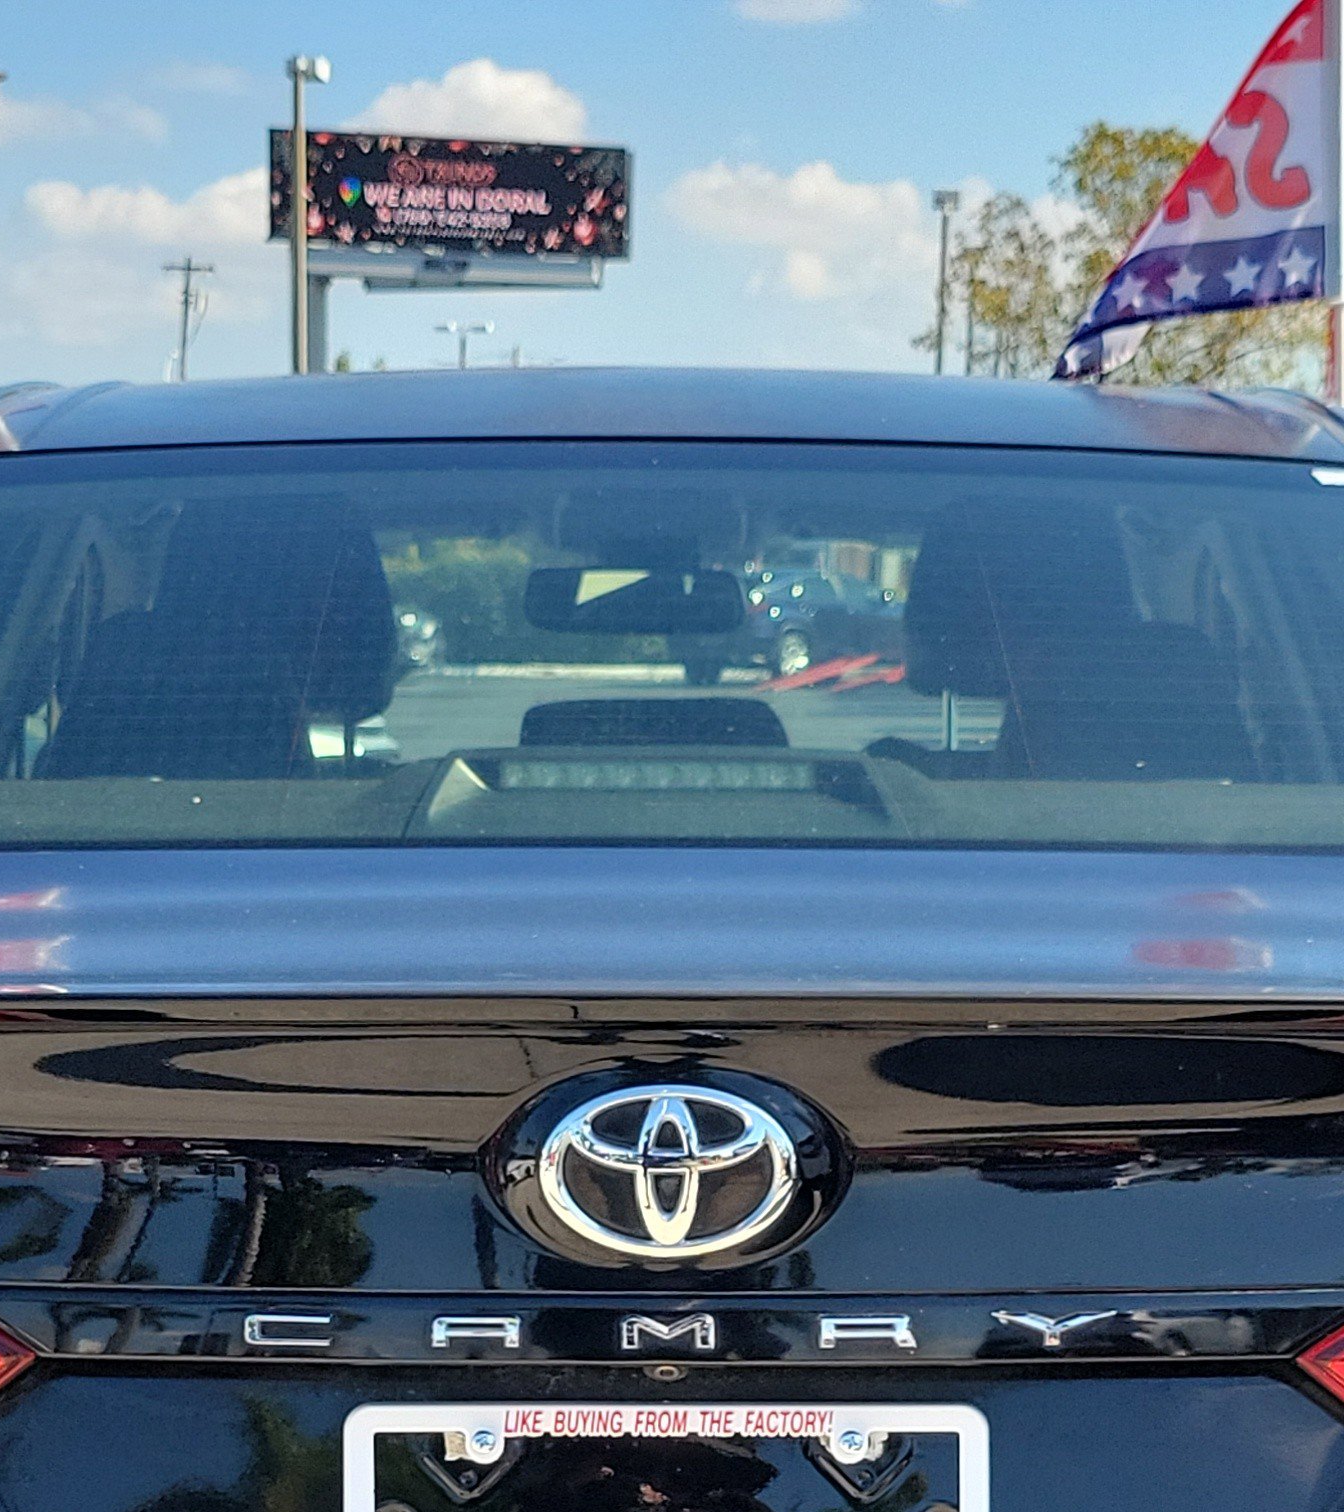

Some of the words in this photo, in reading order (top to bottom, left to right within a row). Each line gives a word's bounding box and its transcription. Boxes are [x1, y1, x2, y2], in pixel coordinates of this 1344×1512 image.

[244, 1311, 1117, 1349] CAMRY
[504, 1410, 543, 1434] LIKE
[554, 1410, 623, 1434] BUYING
[635, 1410, 688, 1434] FROM
[700, 1410, 734, 1434] THE
[744, 1410, 834, 1434] FACTORY!
